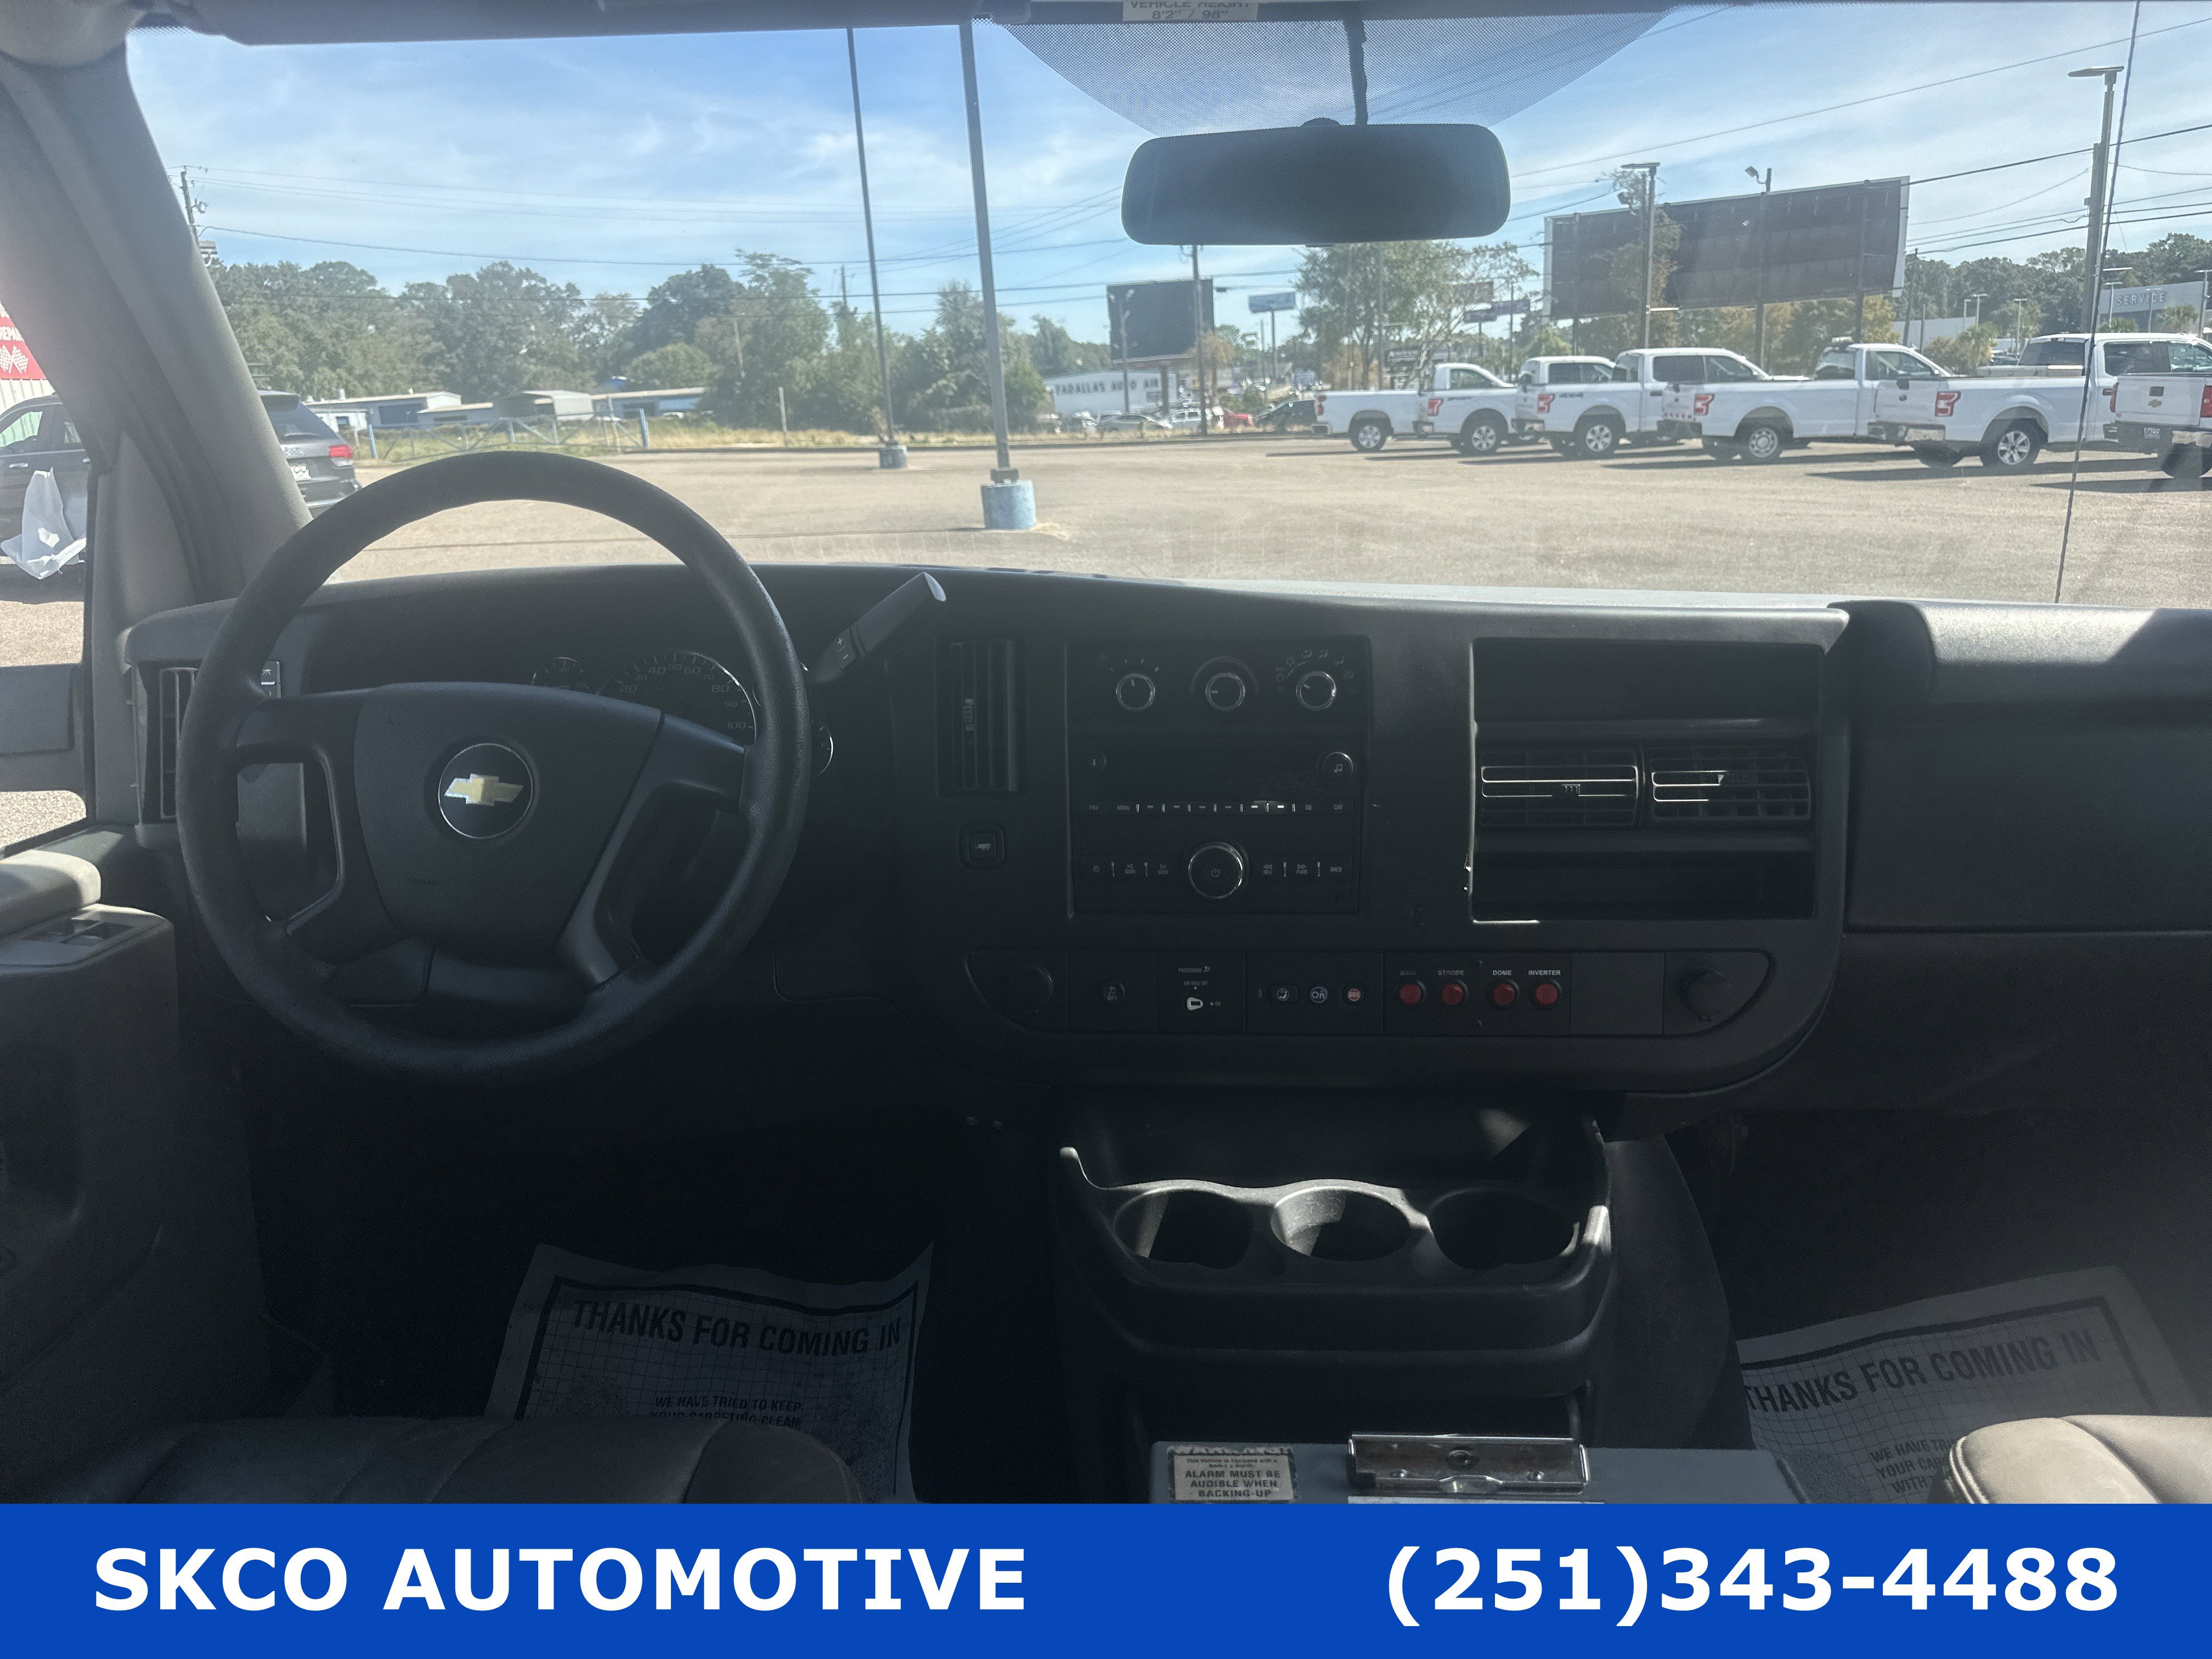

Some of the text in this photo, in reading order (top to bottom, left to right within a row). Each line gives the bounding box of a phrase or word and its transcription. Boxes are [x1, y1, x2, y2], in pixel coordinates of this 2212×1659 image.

[2117, 292, 2166, 306] SERVICE
[1111, 380, 1137, 391] AUO
[648, 667, 667, 675] 40
[683, 667, 701, 675] 60
[619, 685, 637, 693] 20
[711, 684, 729, 693] 80
[574, 1300, 901, 1357] THANKS FOR COMING IN
[1743, 1329, 2101, 1414] THANKS FOR COMING IN
[655, 1396, 802, 1413] WE HAVE TRIED TO KEEP
[1870, 1447, 1895, 1463] WE
[1894, 1440, 1931, 1454] HAVE
[1266, 1470, 1281, 1478] BE
[1876, 1459, 1916, 1479] YOUR
[1892, 1476, 1929, 1493] WITH
